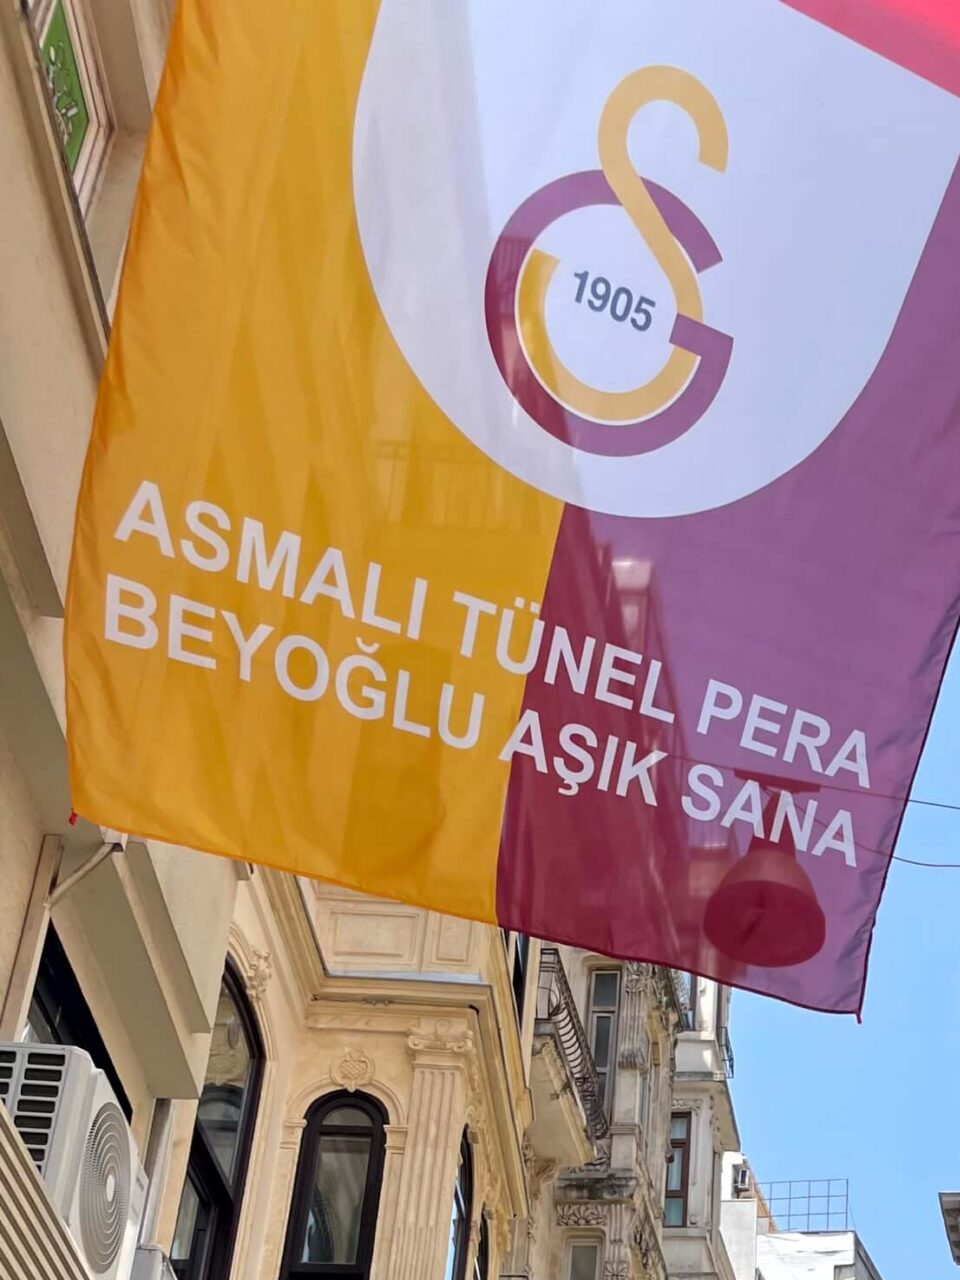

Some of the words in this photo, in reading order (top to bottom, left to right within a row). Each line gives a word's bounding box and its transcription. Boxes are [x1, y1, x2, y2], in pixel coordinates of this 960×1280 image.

[572, 269, 656, 332] 1905
[103, 573, 485, 751] BEYOĞLU
[500, 708, 669, 809] AŞIK
[681, 763, 859, 868] SANA
[114, 480, 427, 642] ASMALI
[453, 591, 676, 724] TÜNEL
[695, 678, 872, 790] PERA
